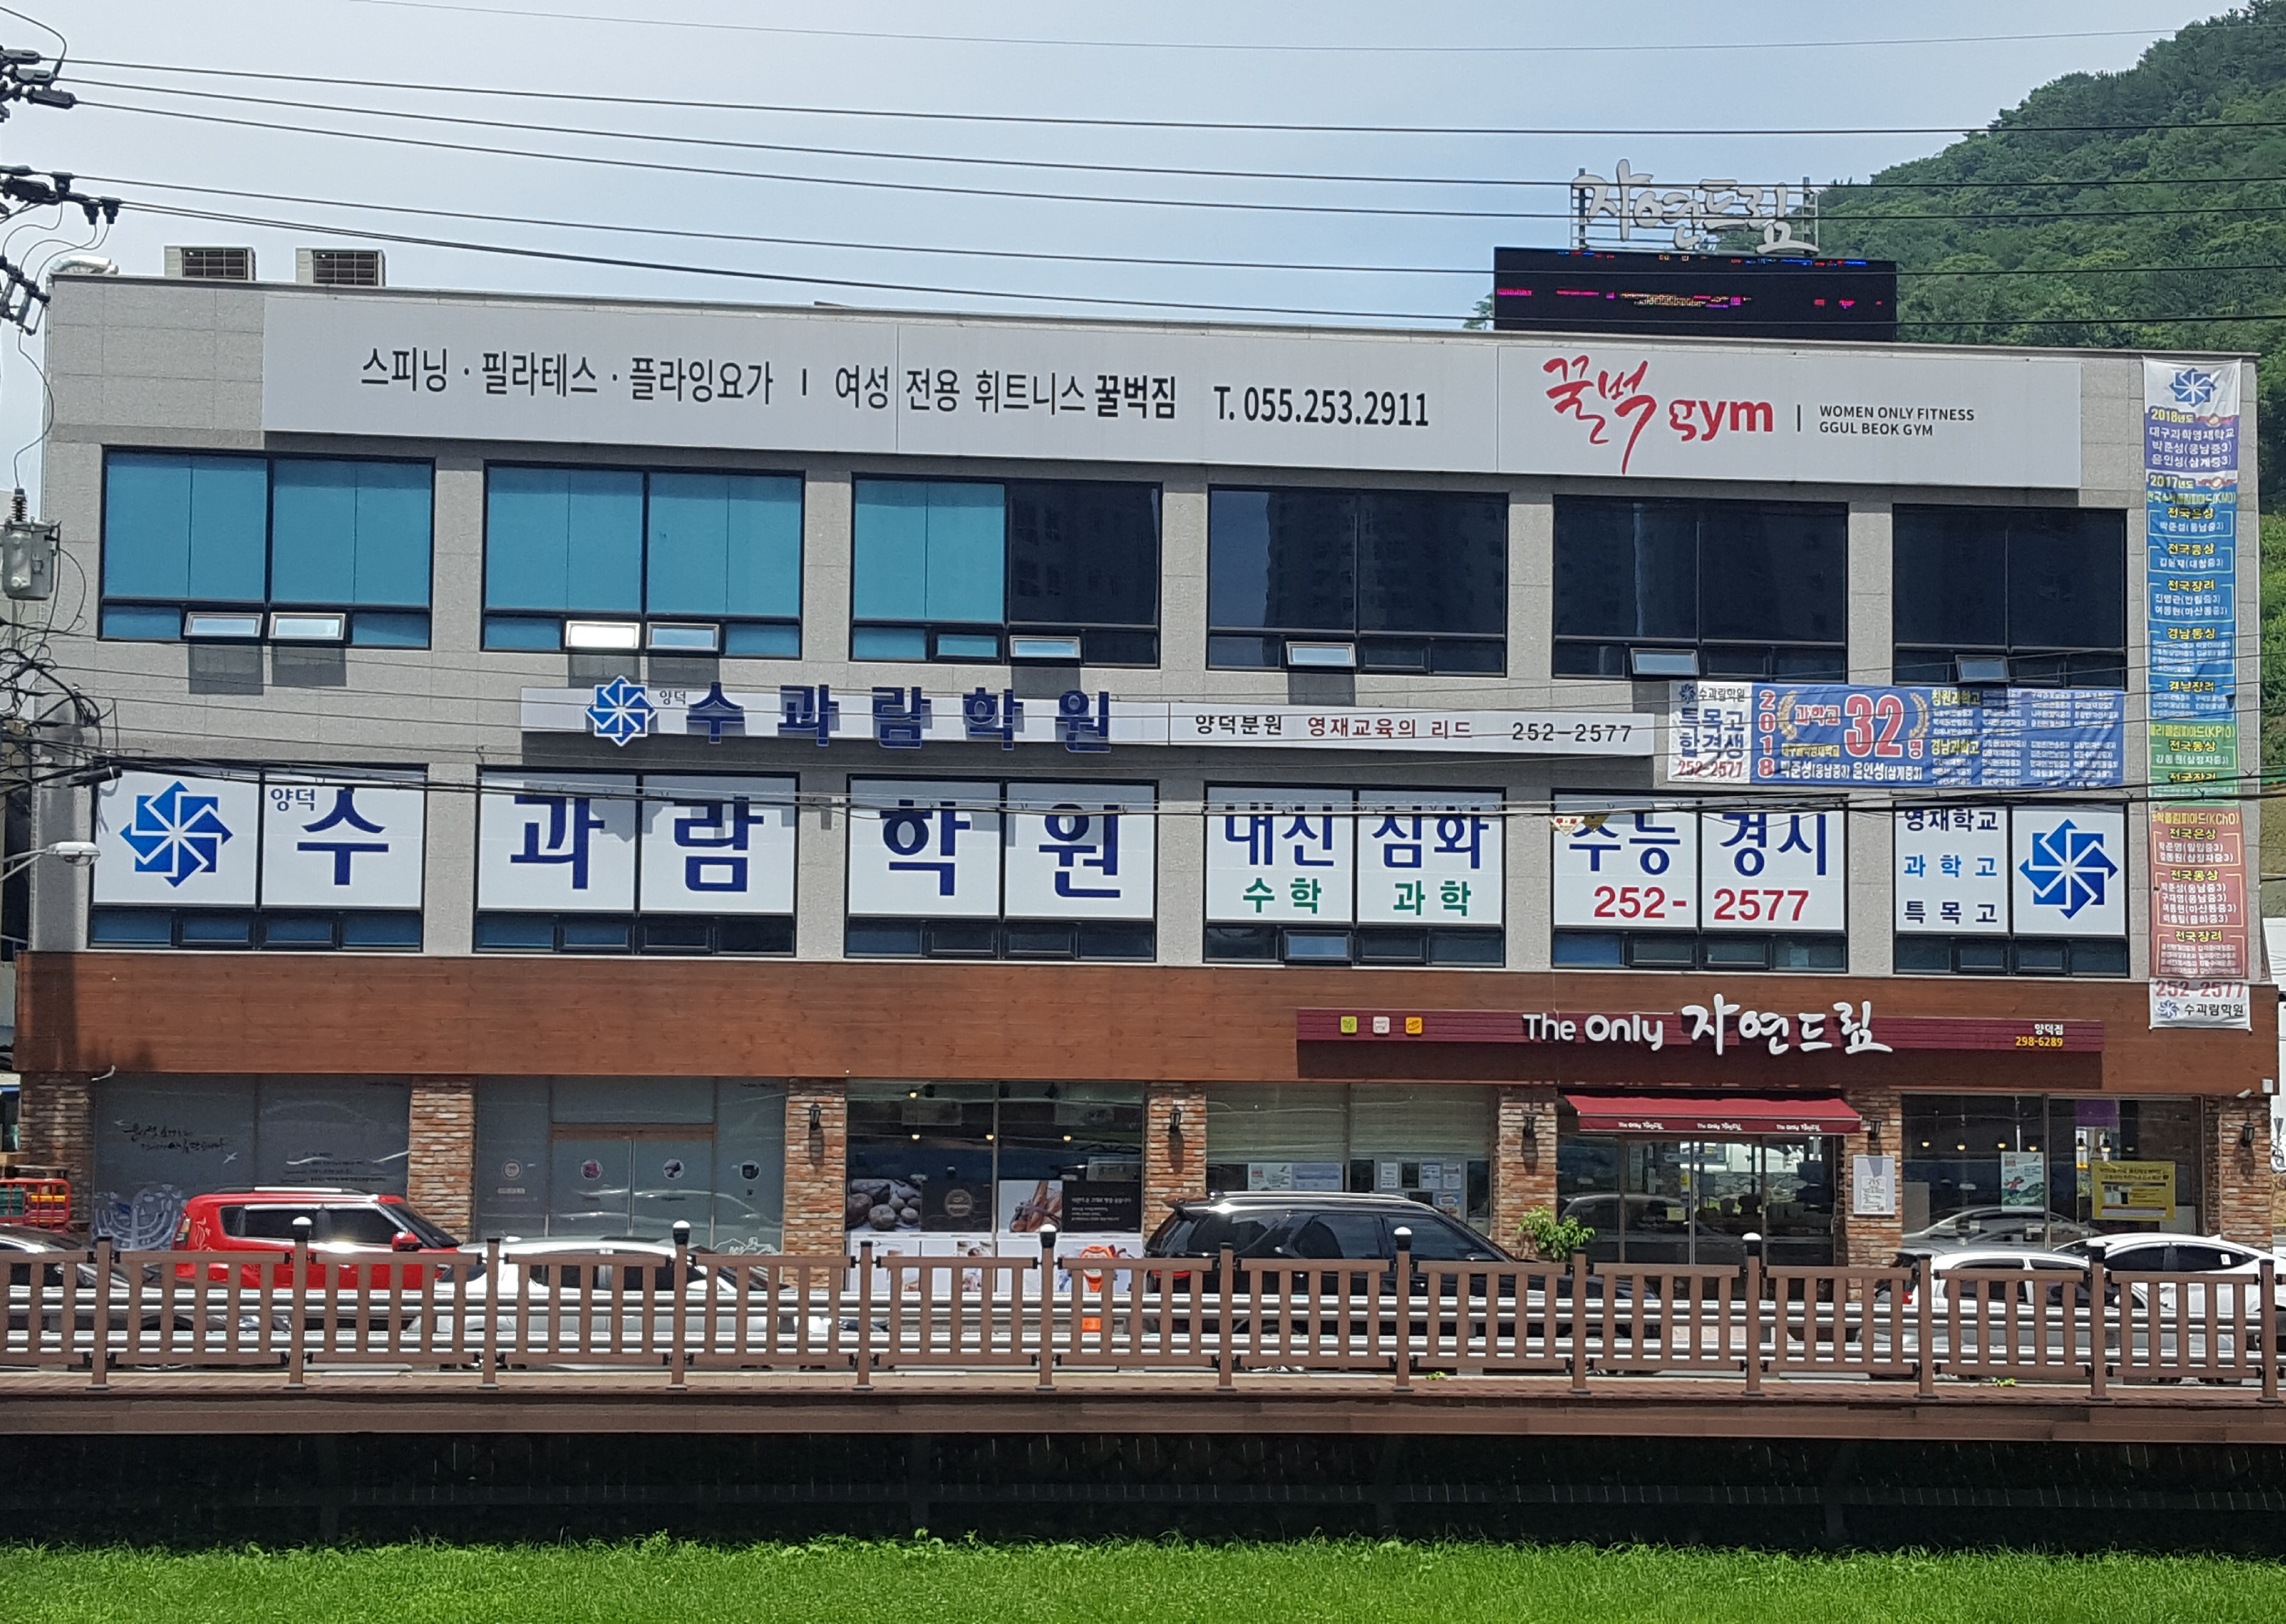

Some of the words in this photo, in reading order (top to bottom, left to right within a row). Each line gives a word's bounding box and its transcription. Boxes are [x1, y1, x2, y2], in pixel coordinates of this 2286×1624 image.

[1571, 159, 1820, 254] 자연드림
[361, 347, 449, 393] 스피닝
[482, 351, 598, 396] 필라테스
[629, 357, 774, 405] 플라잉요가
[835, 365, 889, 410] 여성
[905, 368, 960, 411] 전용
[975, 371, 1086, 416] 휘트니스
[1095, 375, 1175, 419] 꿀벅짐
[1244, 386, 1429, 426] 055.253.2911
[1543, 355, 1656, 474] 꿀벅
[1669, 398, 1773, 441] gym
[1820, 404, 1874, 419] WOMEN
[1877, 405, 1915, 420] ONLY
[1917, 407, 1975, 421] FITNESS
[2151, 409, 2194, 422] 2018년도
[1820, 421, 1858, 434] GGUL
[1862, 422, 1900, 435] BEOK
[1903, 422, 1934, 436] GYM
[2149, 427, 2235, 440] 대구과학영재학교
[2150, 475, 2194, 488] 2017년도
[2168, 507, 2215, 519] 전국은상
[2168, 543, 2215, 555] 전국동상
[2168, 580, 2215, 592] 전국장려
[2168, 628, 2215, 639] 경남동상
[1699, 688, 1745, 702] 수과람학원
[1932, 689, 1980, 706] 창원과학고
[659, 690, 686, 706] 양덕
[686, 681, 1111, 753] 수과람학원
[1679, 707, 1744, 734] 특목고
[1795, 706, 1840, 726] 과학고
[1196, 714, 1282, 736] 양덕분원
[1307, 717, 1416, 739] 영재교육의
[1431, 720, 1472, 739] 리드
[1512, 723, 1631, 742] 252-2577
[1679, 733, 1744, 759] 합격생
[1931, 739, 1979, 755] 경남과학고
[2169, 741, 2216, 752] 전국동상
[1678, 761, 1743, 777] 252-2577
[270, 788, 314, 812] 양덕
[1903, 808, 1998, 833] 영재학교
[1225, 805, 1337, 866] 내신
[1372, 805, 1489, 870] 심화
[2169, 828, 2216, 839] 전국은상
[1569, 811, 1680, 875] 수능
[1721, 811, 1827, 878] 경시
[1903, 854, 1998, 878] 과학고
[2171, 870, 2218, 881] 전국동상
[1242, 877, 1322, 915] 수학
[1393, 879, 1471, 916] 과학
[1903, 901, 1998, 924] 특목고
[2175, 931, 2222, 942] 전국장려
[2185, 1004, 2244, 1017] 수과람학원
[1523, 1013, 1577, 1043] The
[1584, 1013, 1664, 1053] Only
[1680, 993, 1893, 1056] 자연드림
[2033, 1023, 2064, 1037] 양덕점
[2015, 1036, 2064, 1049] 298-6289
